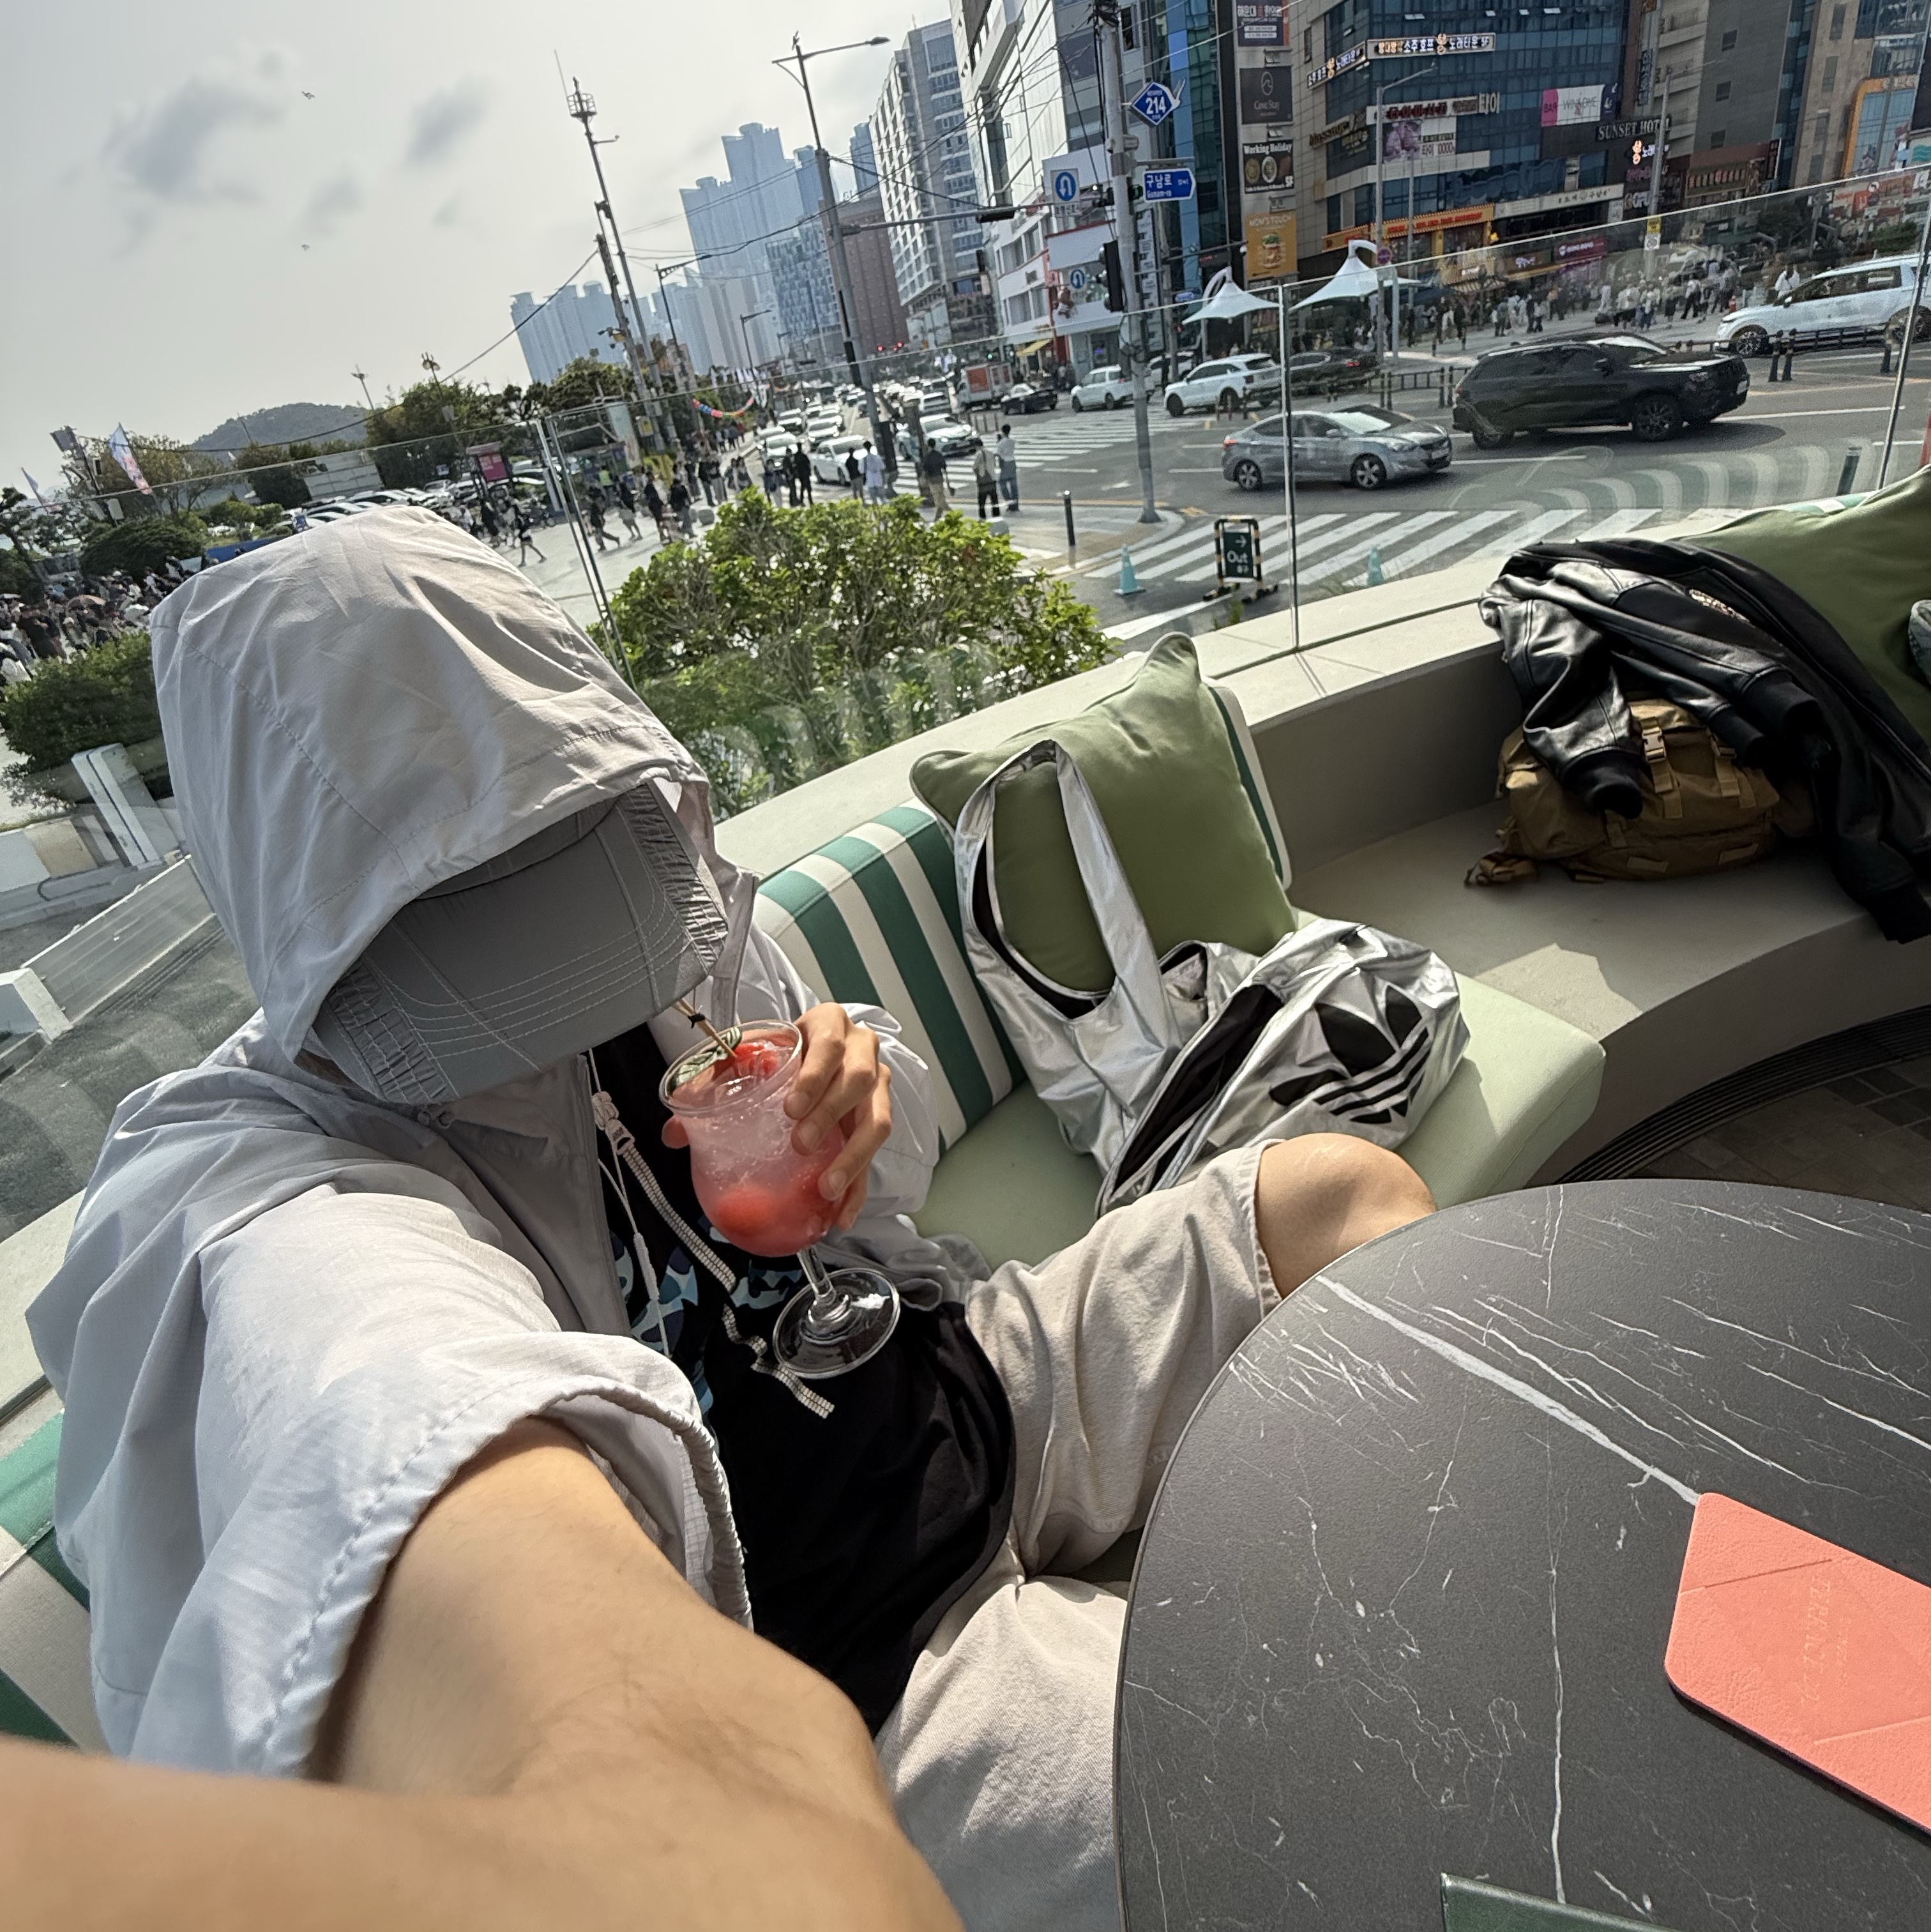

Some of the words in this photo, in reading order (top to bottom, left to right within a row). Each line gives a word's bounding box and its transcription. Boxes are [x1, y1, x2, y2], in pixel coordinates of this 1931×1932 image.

[1238, 5, 1257, 17] 해운대
[1449, 36, 1479, 50] 노래타운
[1145, 96, 1166, 115] 214
[1479, 91, 1500, 115] 타이
[1598, 121, 1637, 141] SUNSET
[1640, 118, 1671, 134] HOTL
[1243, 144, 1269, 155] Working
[1269, 142, 1293, 153] Holiday
[1146, 174, 1172, 189] 구남로
[1227, 550, 1248, 563] Out
